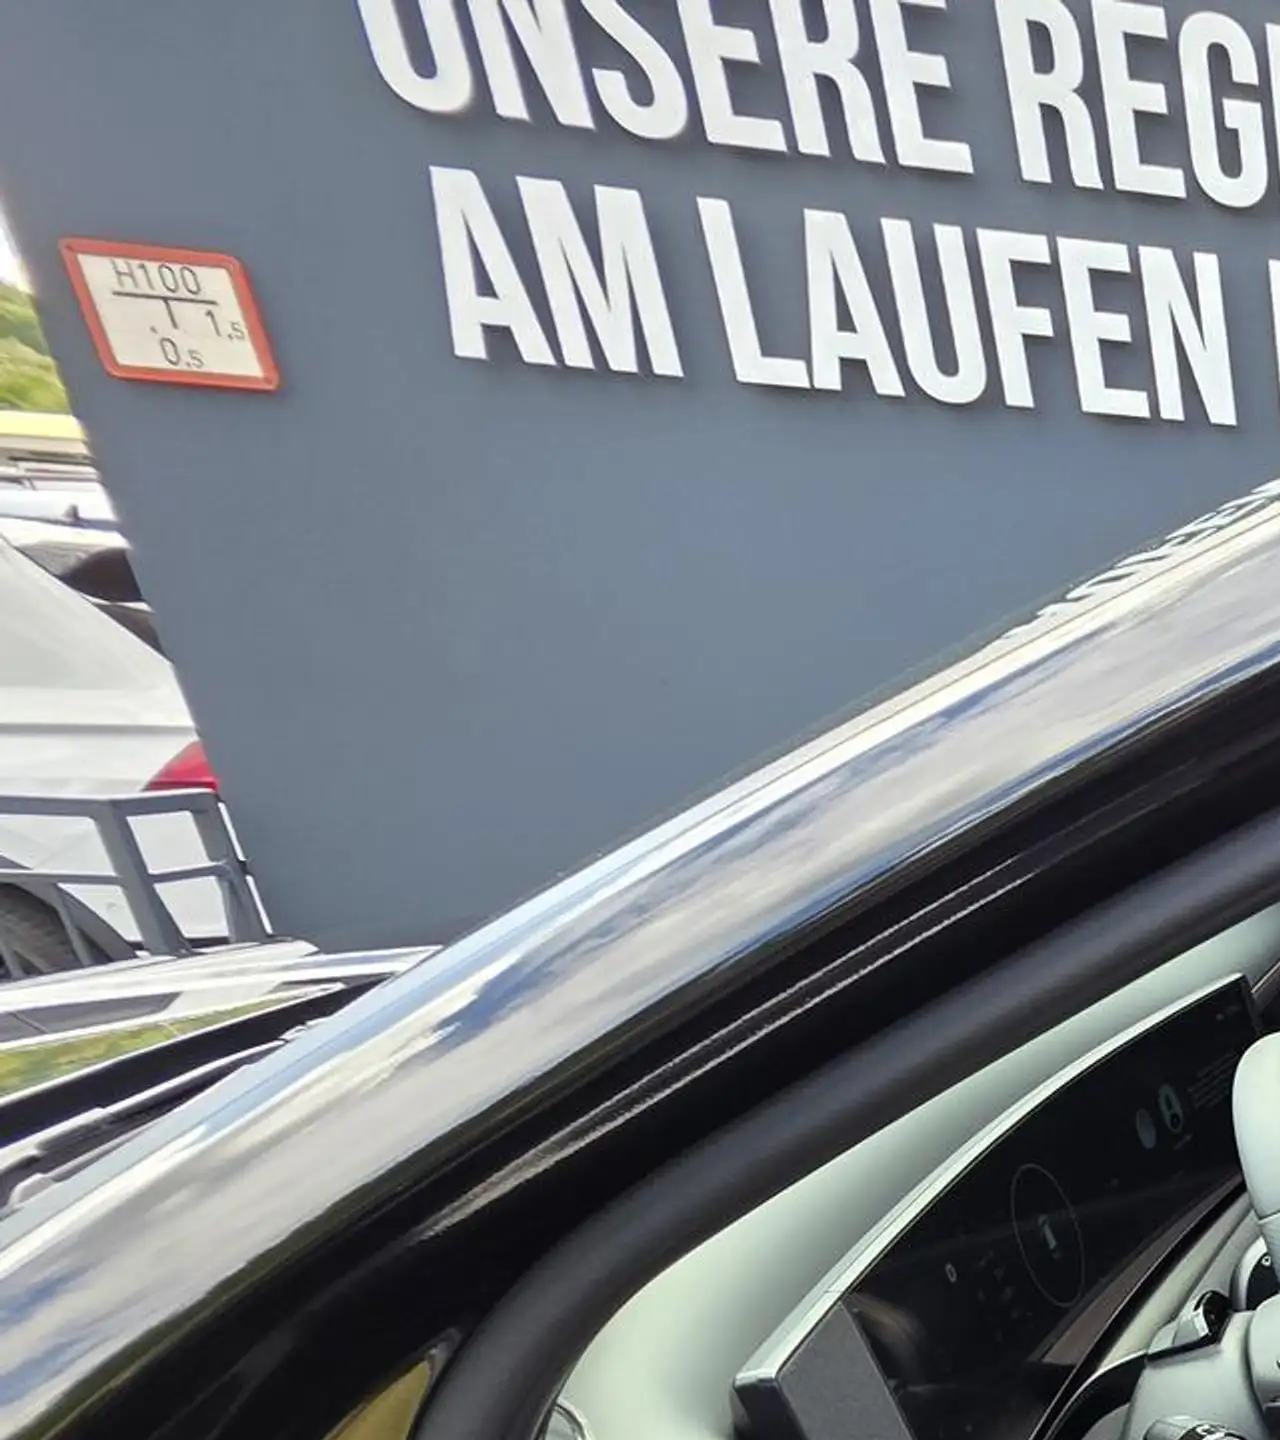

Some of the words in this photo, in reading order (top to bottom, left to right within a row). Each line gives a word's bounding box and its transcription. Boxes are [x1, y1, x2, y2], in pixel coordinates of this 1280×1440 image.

[357, 0, 974, 174] UNSERE
[111, 258, 202, 296] H100
[429, 166, 685, 378] AM
[697, 196, 1237, 427] LAUFEN
